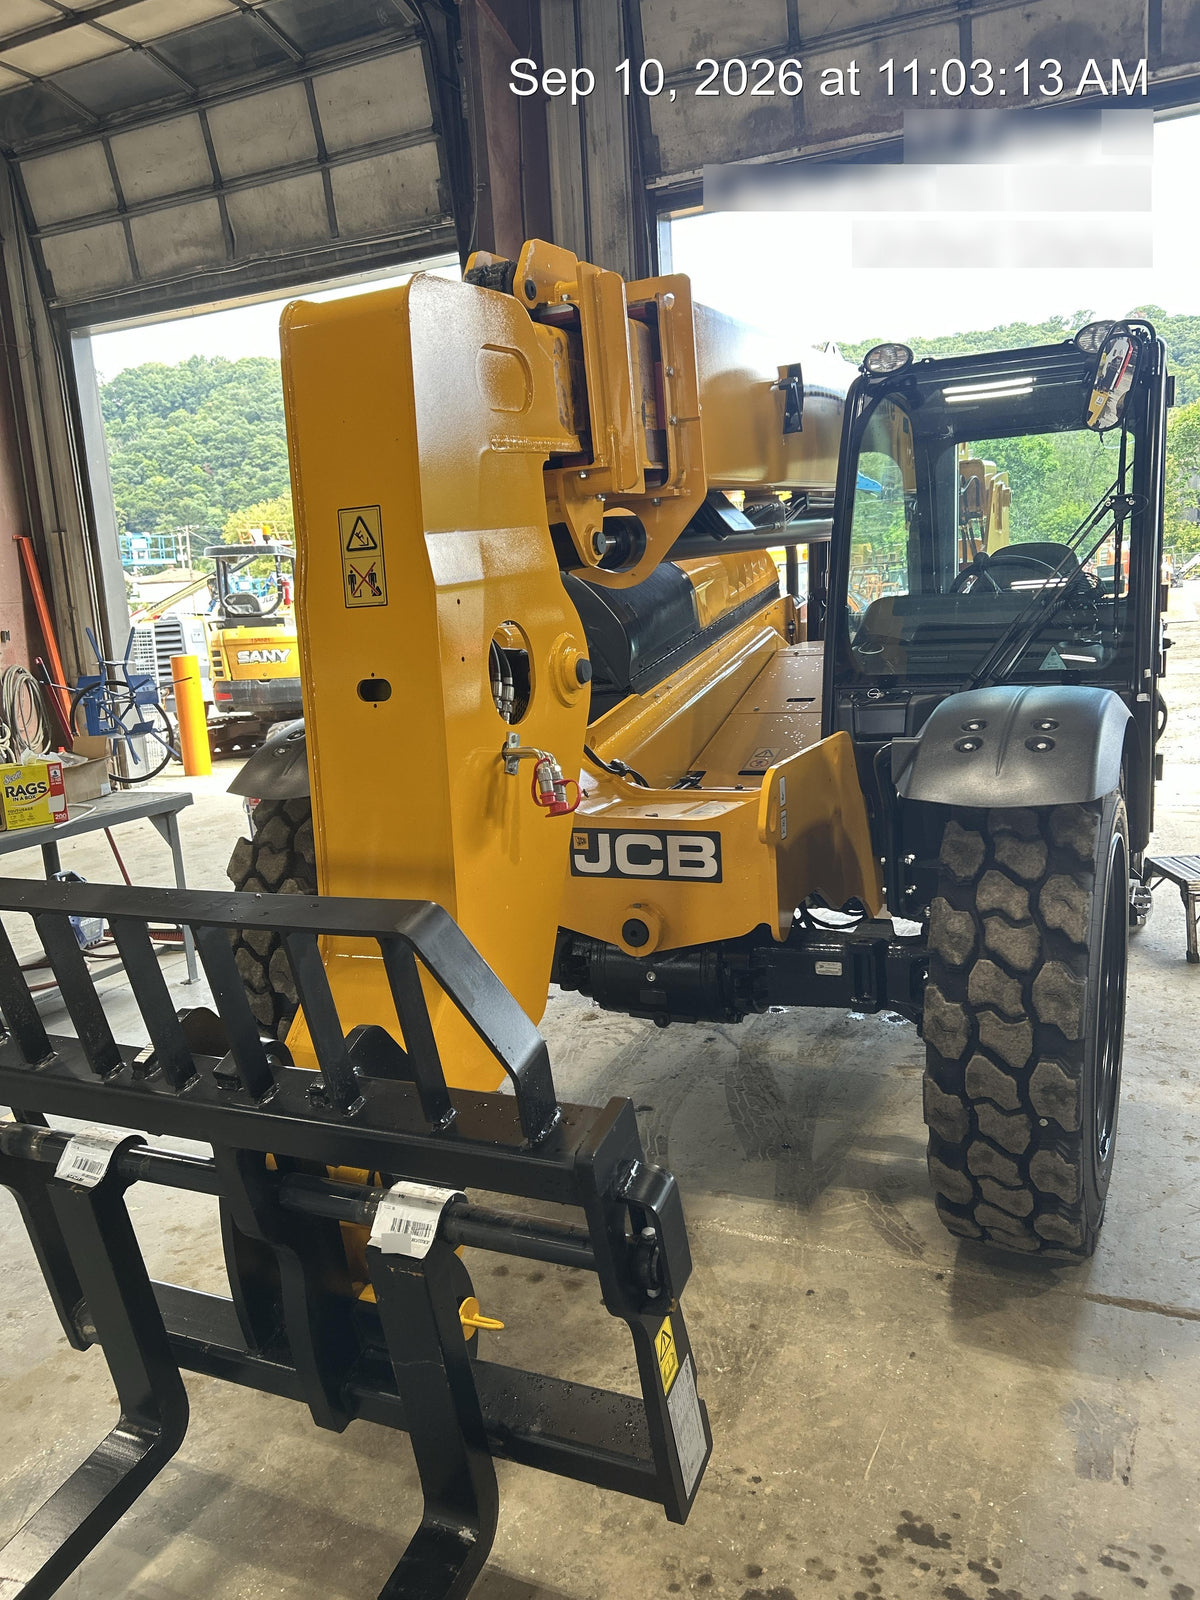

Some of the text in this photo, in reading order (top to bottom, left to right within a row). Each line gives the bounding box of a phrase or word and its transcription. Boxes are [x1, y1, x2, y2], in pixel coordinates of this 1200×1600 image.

[237, 648, 291, 665] SANY
[5, 782, 47, 798] RAGS
[574, 833, 718, 878] JCB
